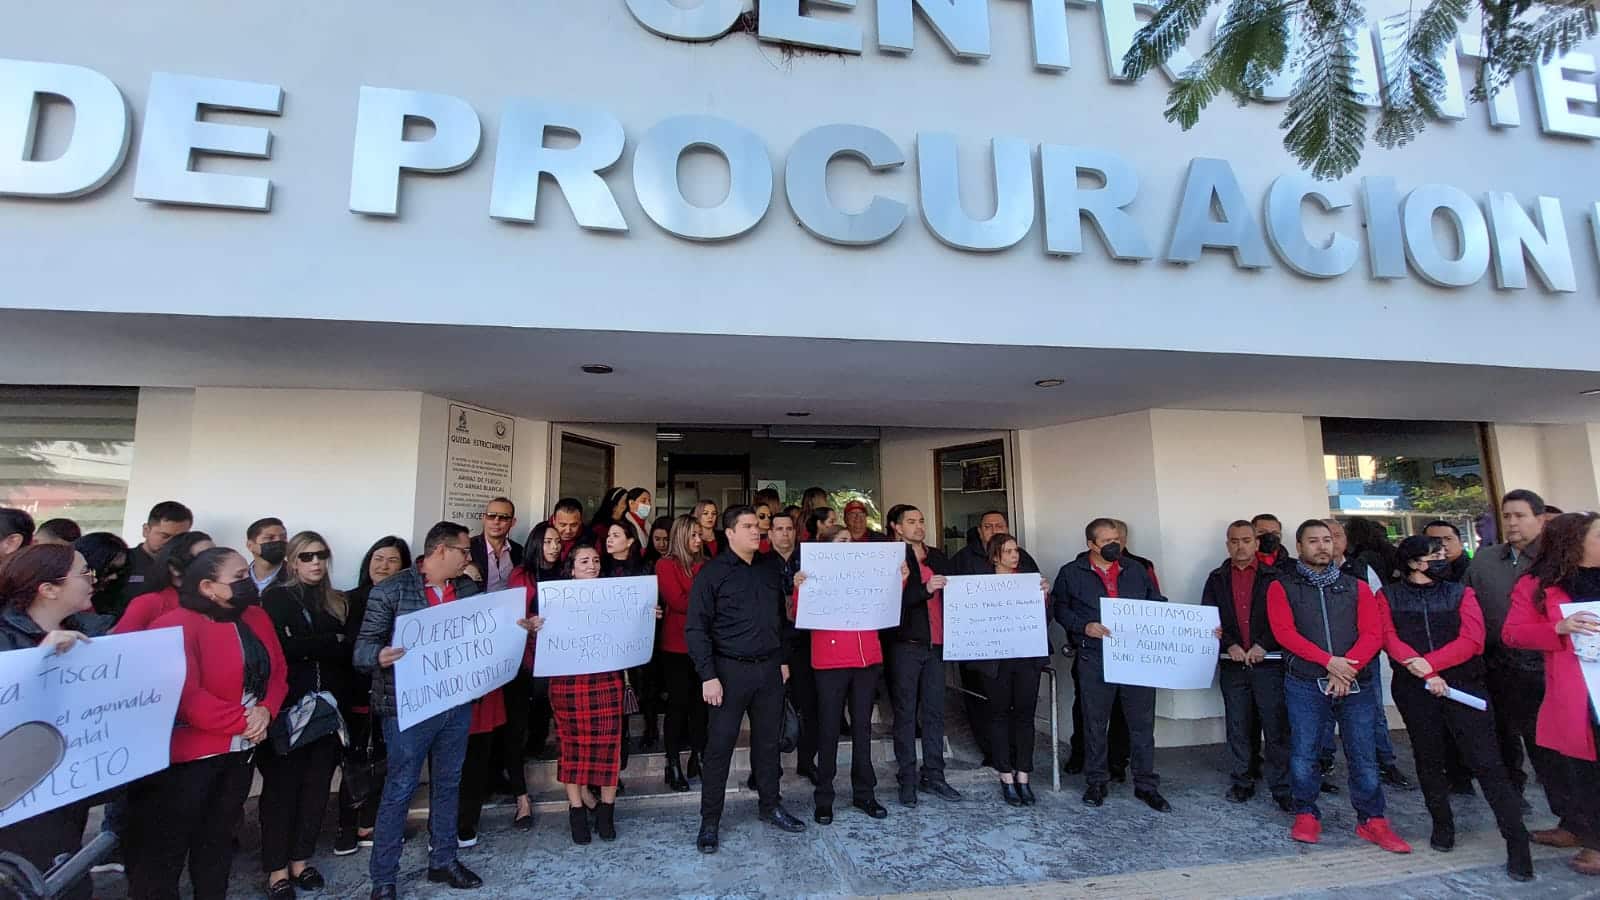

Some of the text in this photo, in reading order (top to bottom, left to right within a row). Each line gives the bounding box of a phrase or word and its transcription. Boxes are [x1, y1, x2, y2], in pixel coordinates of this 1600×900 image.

[0, 58, 284, 211] DE
[343, 84, 1577, 294] PROCURACION
[451, 511, 486, 521] SIN EXCE
[402, 608, 497, 651] QUEREMOS
[1135, 622, 1165, 637] PAGO
[422, 637, 494, 676] NUESTRO
[1110, 637, 1126, 648] DEL
[1136, 639, 1194, 654] AGUINALDO
[1140, 654, 1177, 666] ESTATAL
[56, 688, 162, 726] el aguinaldo
